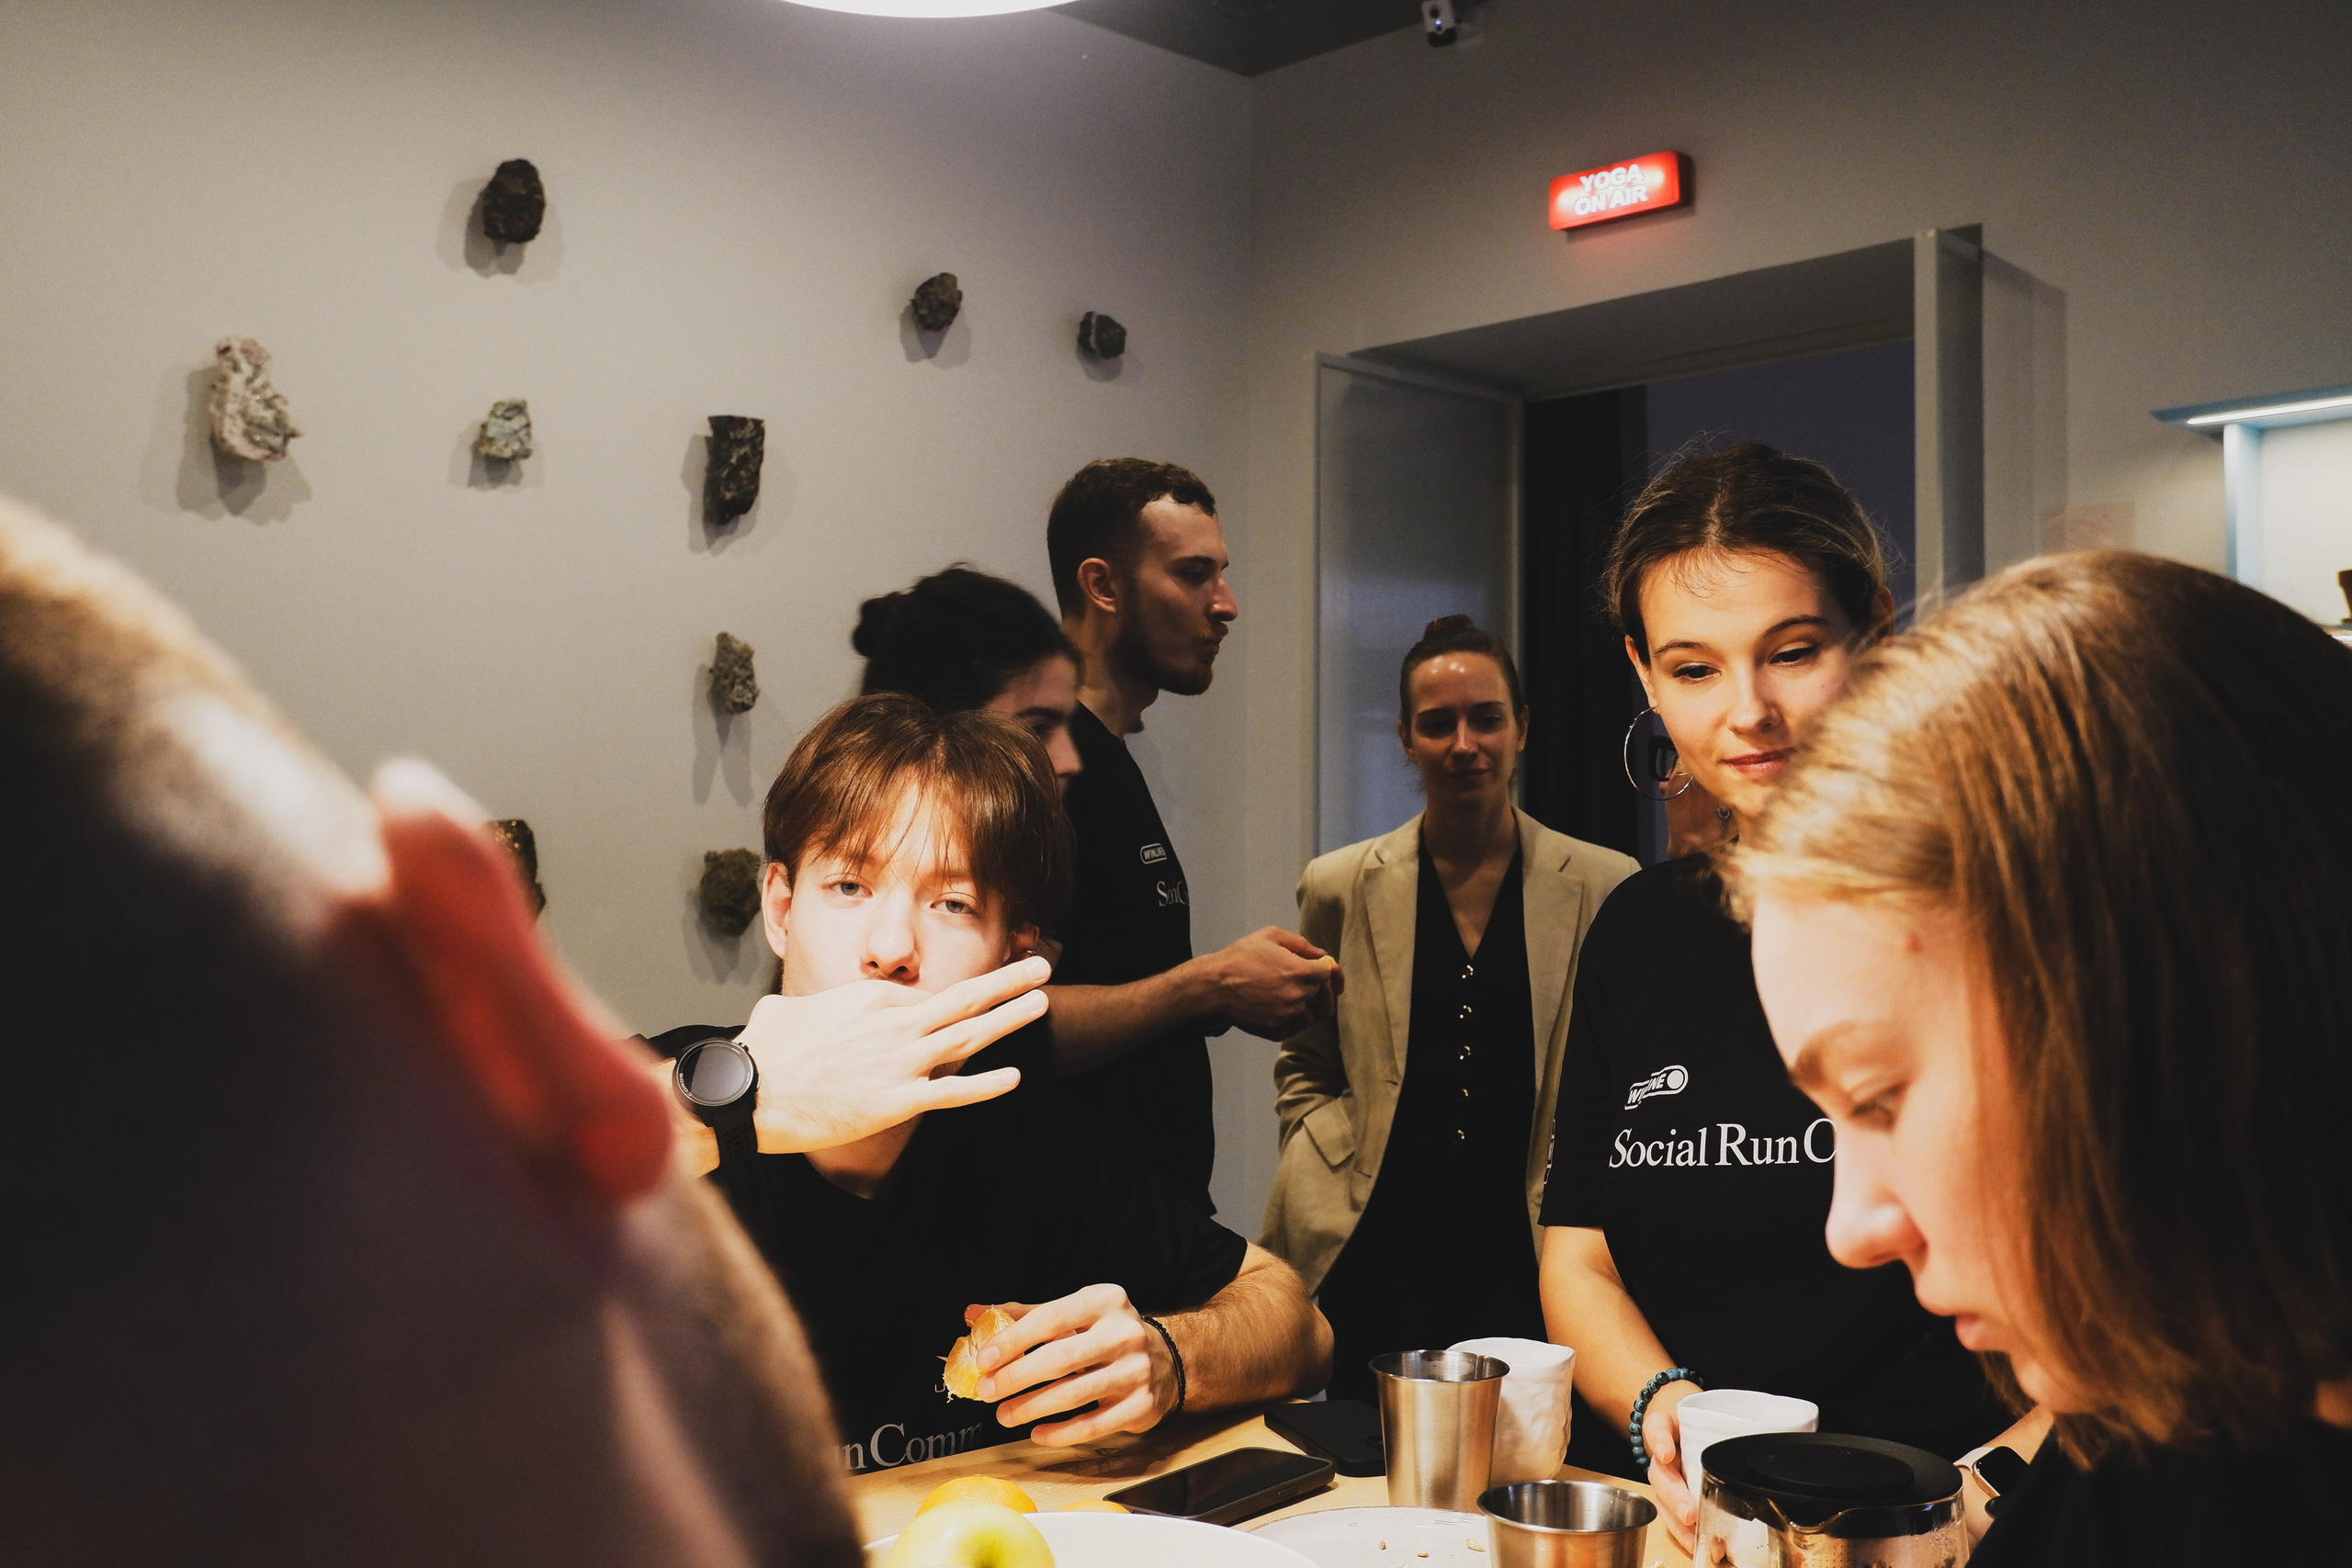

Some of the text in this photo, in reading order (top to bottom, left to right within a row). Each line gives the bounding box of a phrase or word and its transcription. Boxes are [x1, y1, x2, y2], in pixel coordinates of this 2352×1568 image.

[1579, 164, 1645, 193] YOGA
[1574, 185, 1648, 216] ON AIR
[1609, 1117, 1838, 1168] Social Run C
[870, 1423, 983, 1467] Comm
